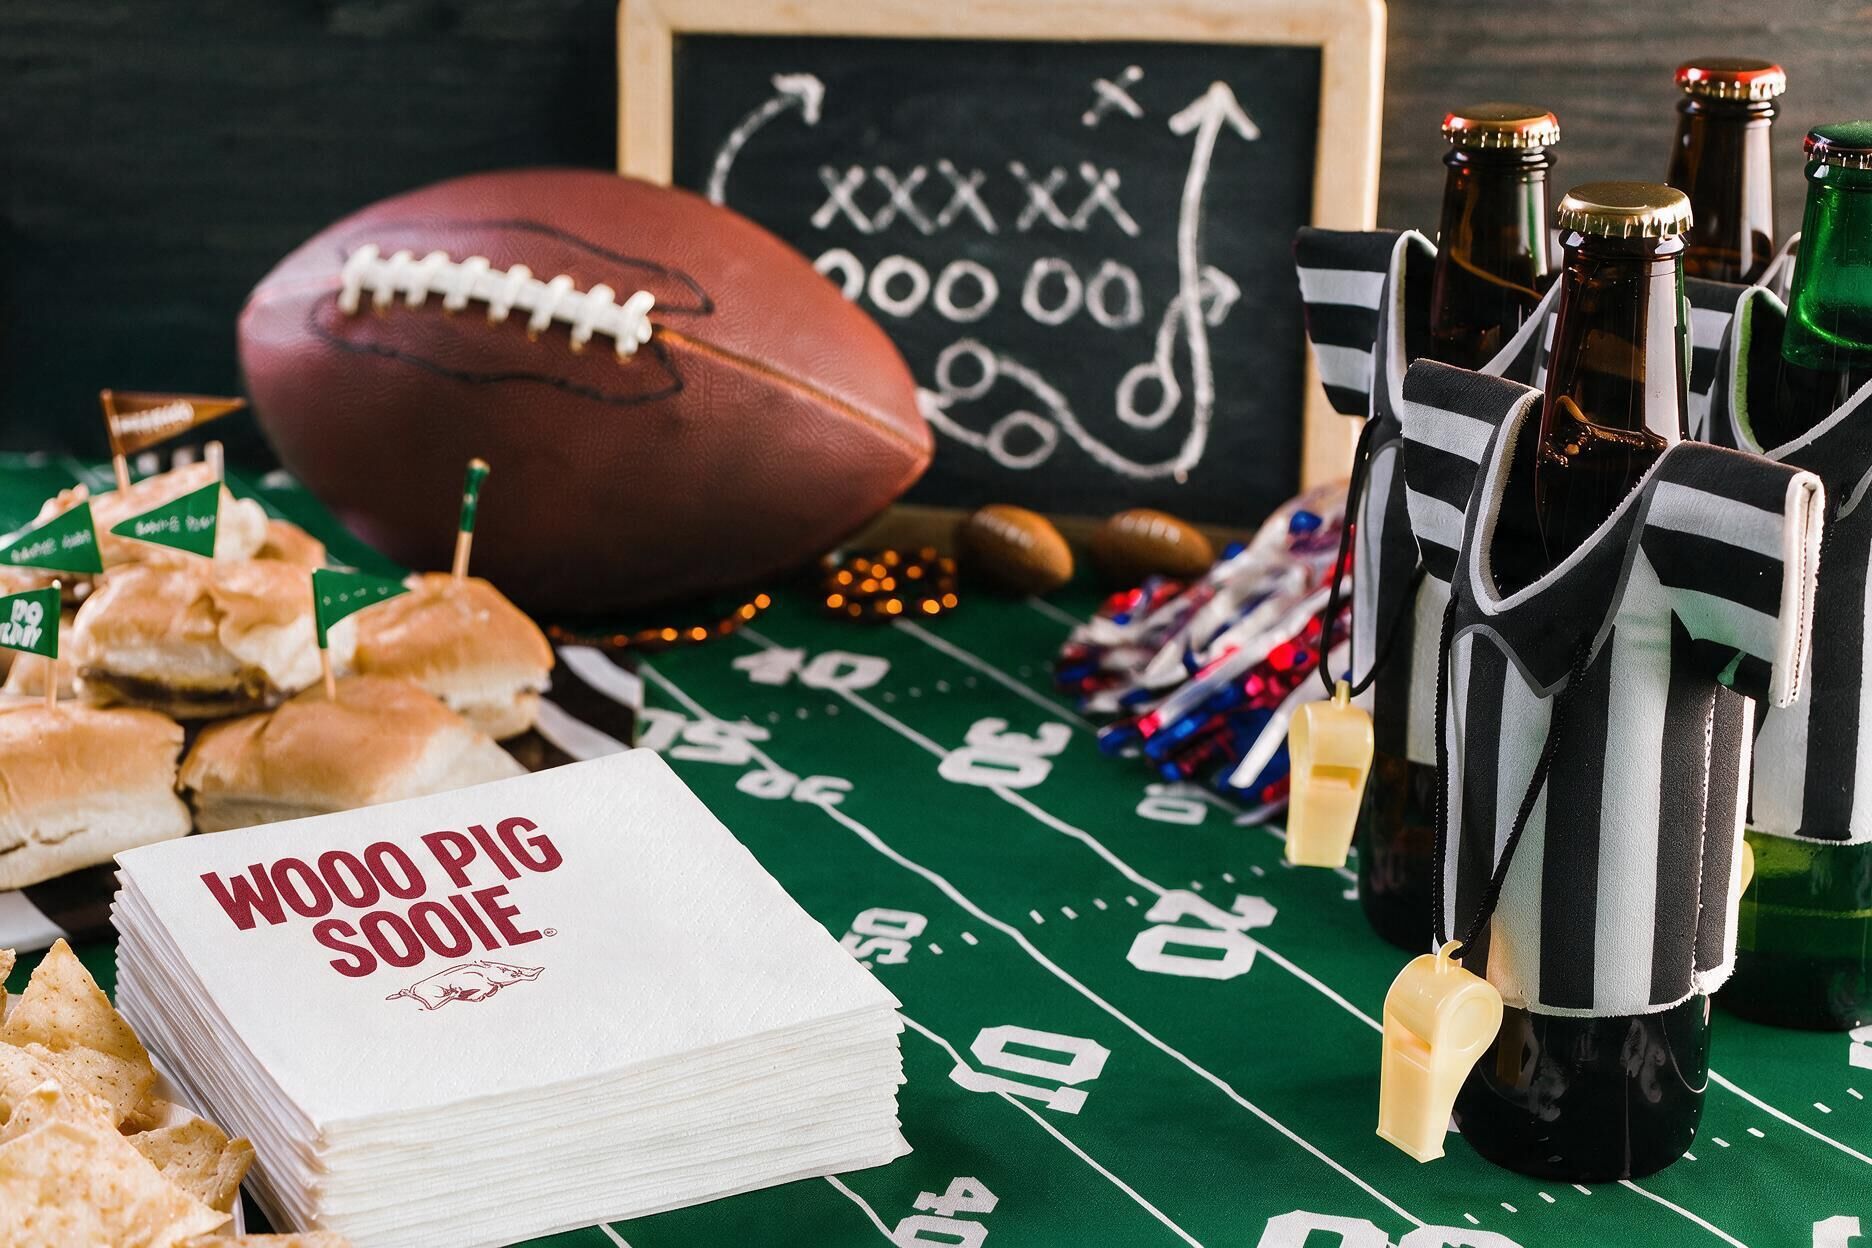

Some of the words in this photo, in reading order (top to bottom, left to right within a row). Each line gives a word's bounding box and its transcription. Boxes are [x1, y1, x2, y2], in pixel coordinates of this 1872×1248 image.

[937, 717, 1073, 790] 30
[200, 840, 427, 931] WOOO
[420, 815, 564, 889] PIG
[312, 884, 544, 978] SOOIE
[1126, 889, 1279, 981] 20
[948, 1024, 1112, 1116] 10
